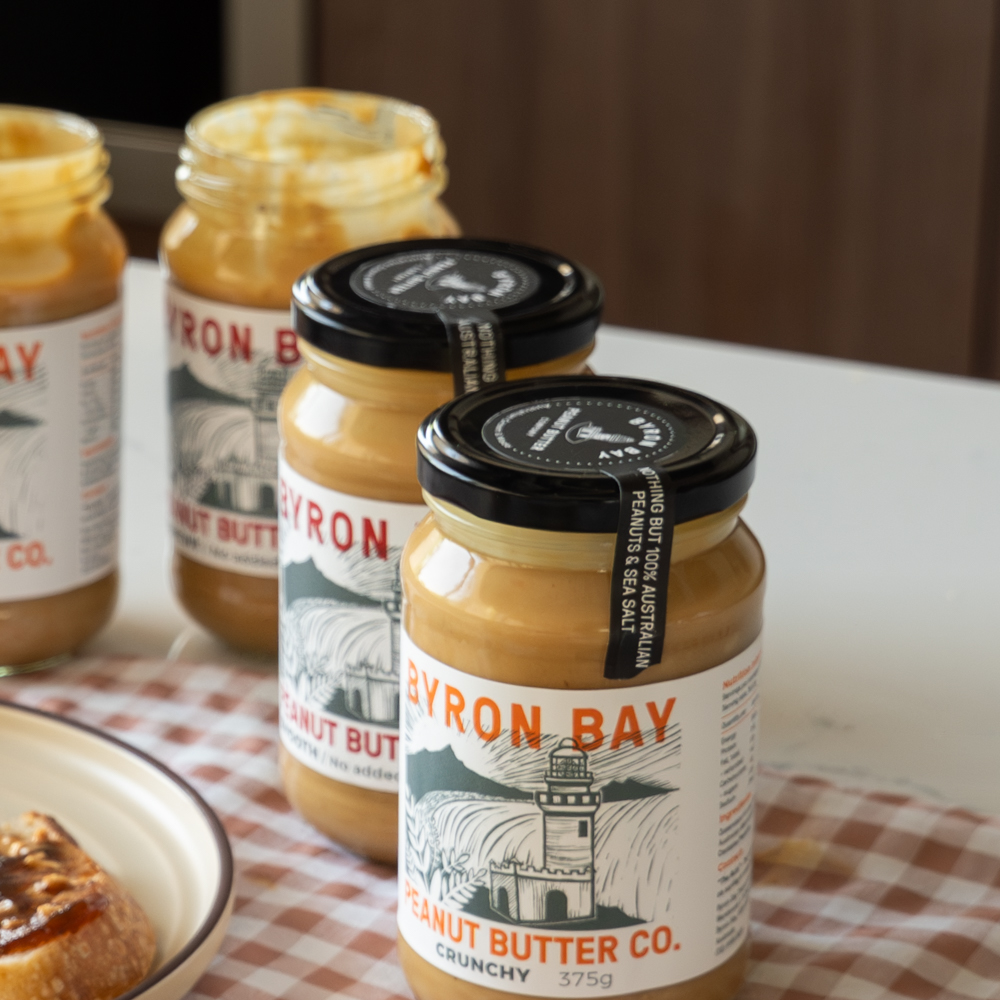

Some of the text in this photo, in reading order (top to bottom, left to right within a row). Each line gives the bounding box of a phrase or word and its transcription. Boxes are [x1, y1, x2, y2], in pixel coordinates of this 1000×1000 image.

[166, 303, 253, 363] YRON
[5, 539, 53, 571] CO.
[216, 517, 279, 551] BUTT
[647, 517, 664, 544] BUT
[621, 490, 646, 633] PEANUTS & SEA SALT
[642, 547, 661, 581] 100%
[635, 584, 657, 668] AUSTRALIAN
[406, 657, 542, 751] BYRON
[571, 697, 677, 752] BAY
[345, 726, 400, 761] BUT
[403, 877, 682, 966] PEANUT BUTTER CO.
[435, 941, 614, 990] CRUNCHY 375g
